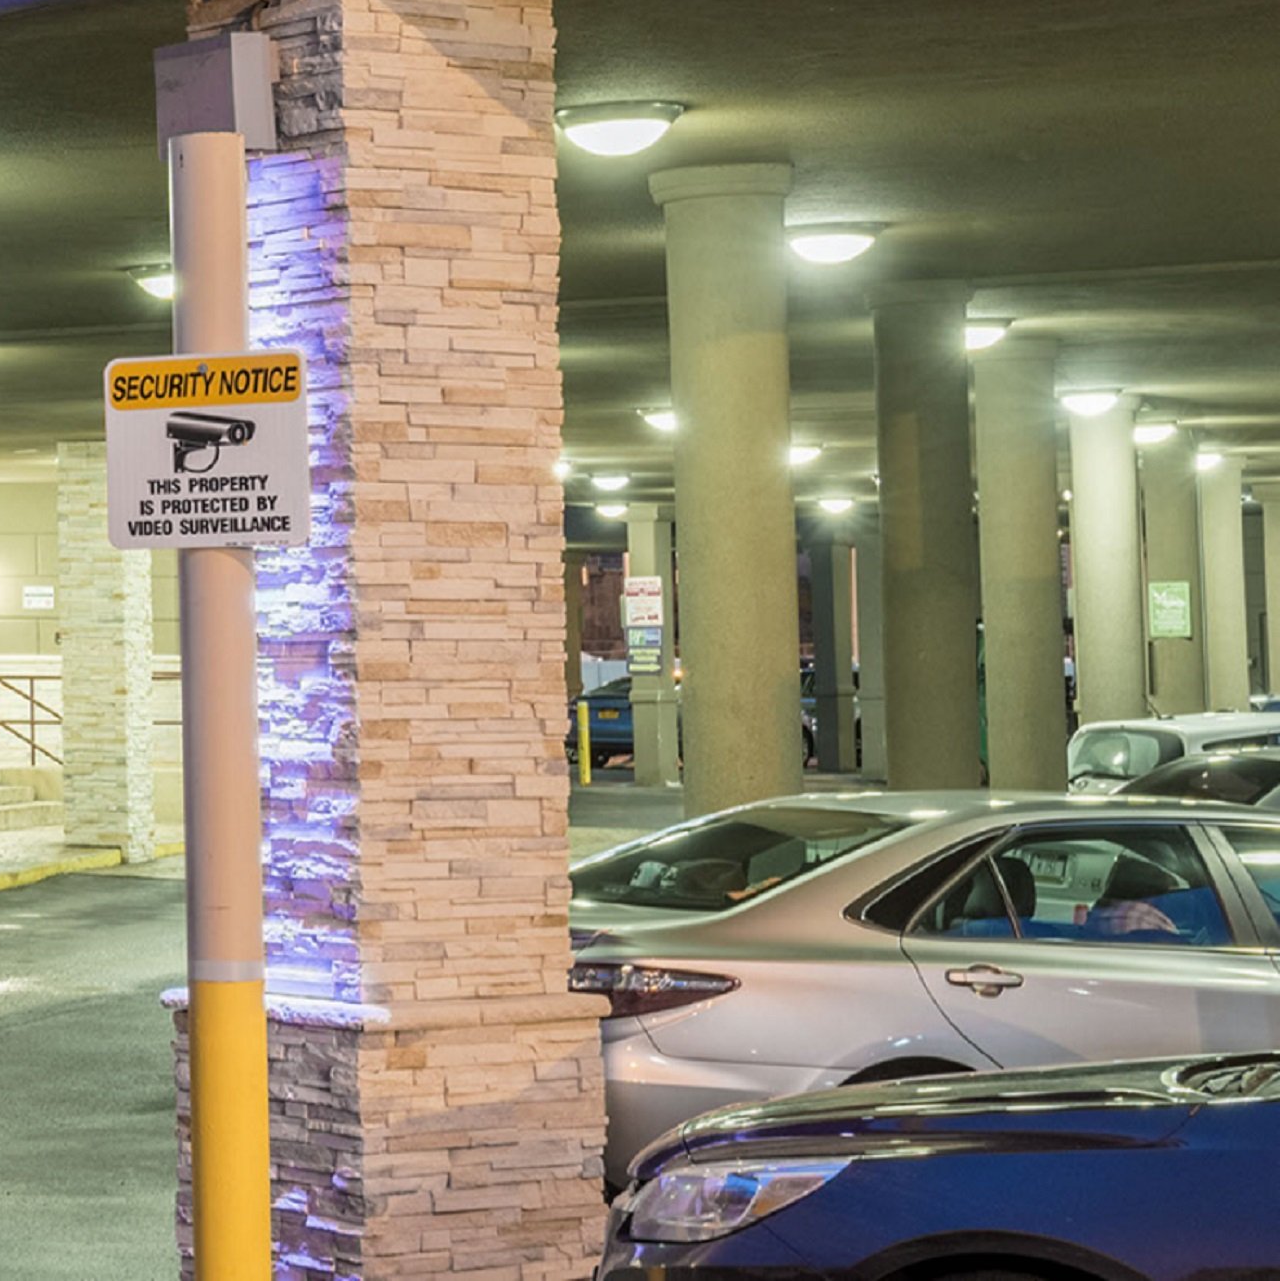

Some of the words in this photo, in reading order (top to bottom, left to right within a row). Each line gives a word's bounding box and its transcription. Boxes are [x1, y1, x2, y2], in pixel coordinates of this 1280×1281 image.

[112, 370, 216, 403] SECURITY
[218, 366, 299, 395] NOTICE
[147, 478, 181, 495] THIS
[188, 475, 269, 493] PROPERTY
[140, 500, 154, 516] IS
[161, 497, 249, 515] PROTECTED
[256, 495, 279, 512] BY
[128, 520, 173, 537] VIDEO
[179, 515, 291, 535] SURVEILLANCE
